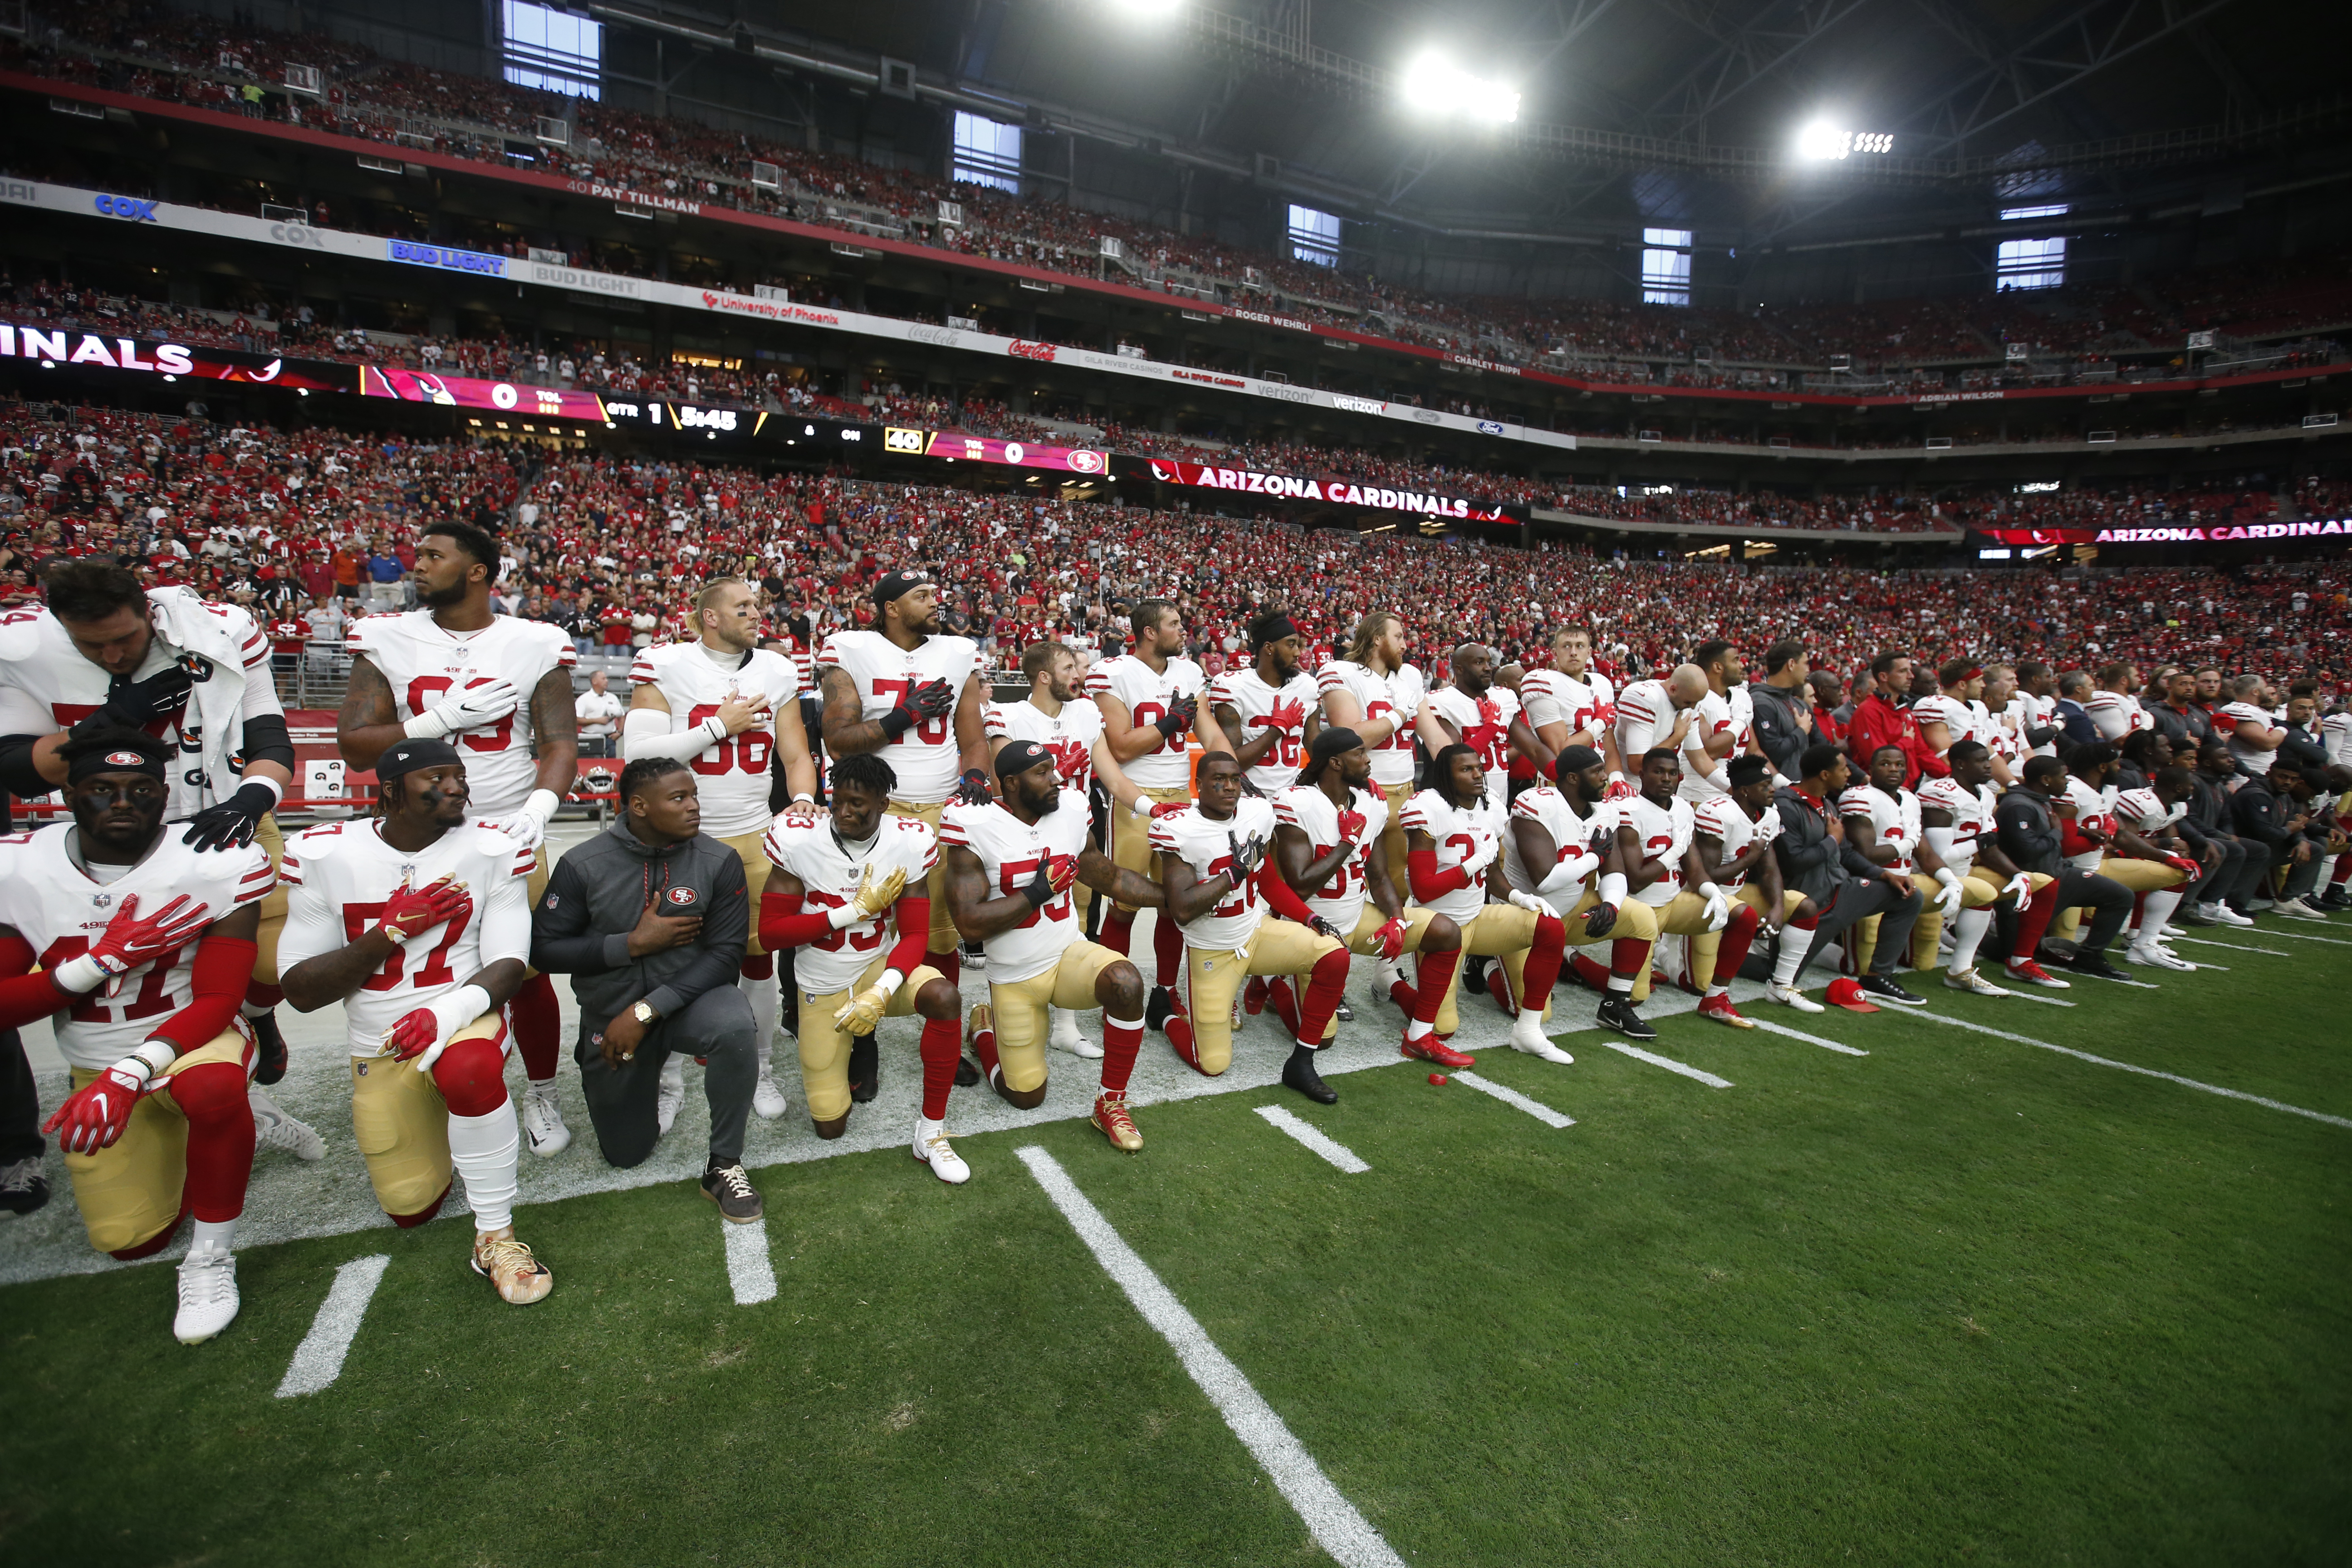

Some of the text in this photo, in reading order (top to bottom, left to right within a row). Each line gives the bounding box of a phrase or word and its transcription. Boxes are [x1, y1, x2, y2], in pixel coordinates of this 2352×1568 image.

[95, 195, 159, 221] COX
[591, 184, 623, 200] PAT
[628, 191, 700, 215] TILLMAN
[270, 225, 324, 247] COX
[392, 244, 503, 274] BUD LIGHT
[536, 267, 636, 294] BUD LIGHT
[66, 293, 77, 302] 32
[722, 297, 838, 325] University of Phoenix
[1221, 306, 1311, 332] 22 ROGER WEHRLI
[1085, 355, 1163, 374] GILA RIVER CASINOS
[1455, 354, 1493, 370] CHARLEY
[1494, 363, 1520, 376] TRIPPI
[1172, 370, 1245, 388] GILA RIVER CASINOS
[492, 383, 518, 409] 0
[536, 390, 563, 404] TOL
[1258, 384, 1309, 402] verizon
[1919, 392, 1959, 402] ADRIAN
[1961, 390, 2004, 401] WILSON
[606, 402, 662, 424] QTR 1
[1333, 396, 1383, 415] verizon
[104, 416, 111, 425] 7
[680, 406, 737, 431] 5:45
[1482, 421, 1499, 433] Ford
[841, 429, 860, 442] ON
[888, 431, 920, 450] 40
[965, 440, 984, 450] TOL
[1005, 443, 1024, 463] 0
[1197, 466, 1469, 518] ARIZONA CARDINALS
[2095, 527, 2206, 543] ARIZONA
[280, 546, 289, 558] 11
[786, 559, 796, 568] 52
[1311, 610, 1319, 618] 32
[278, 623, 297, 637] 52
[1240, 630, 1249, 640] 11
[1238, 655, 1251, 667] 52
[1319, 652, 1331, 663] 33
[1934, 780, 1957, 791] 29
[1706, 797, 1727, 808] 11
[343, 897, 473, 991] 57
